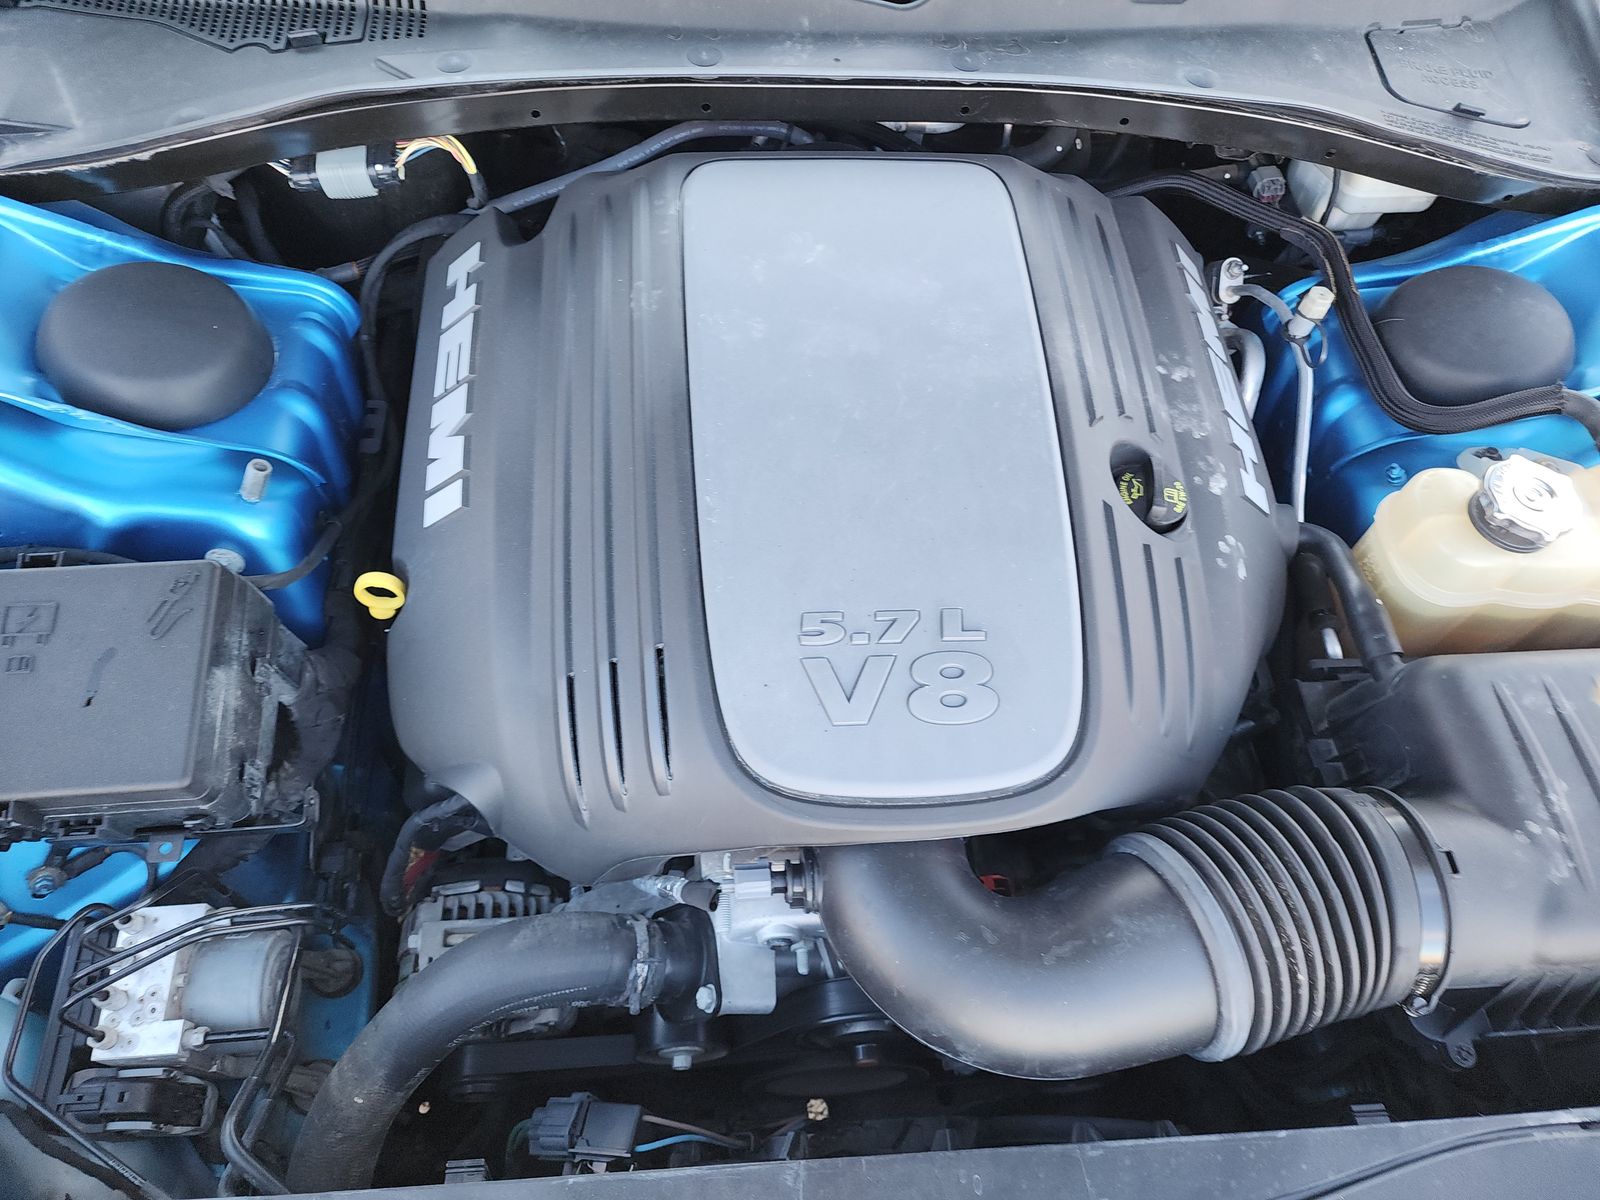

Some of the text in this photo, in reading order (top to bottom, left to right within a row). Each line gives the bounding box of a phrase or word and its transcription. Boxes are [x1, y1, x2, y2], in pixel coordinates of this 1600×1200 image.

[423, 241, 482, 528] HEMI
[1175, 243, 1271, 515] HEMI
[799, 607, 987, 646] 5.7 L
[800, 650, 999, 727] V8
